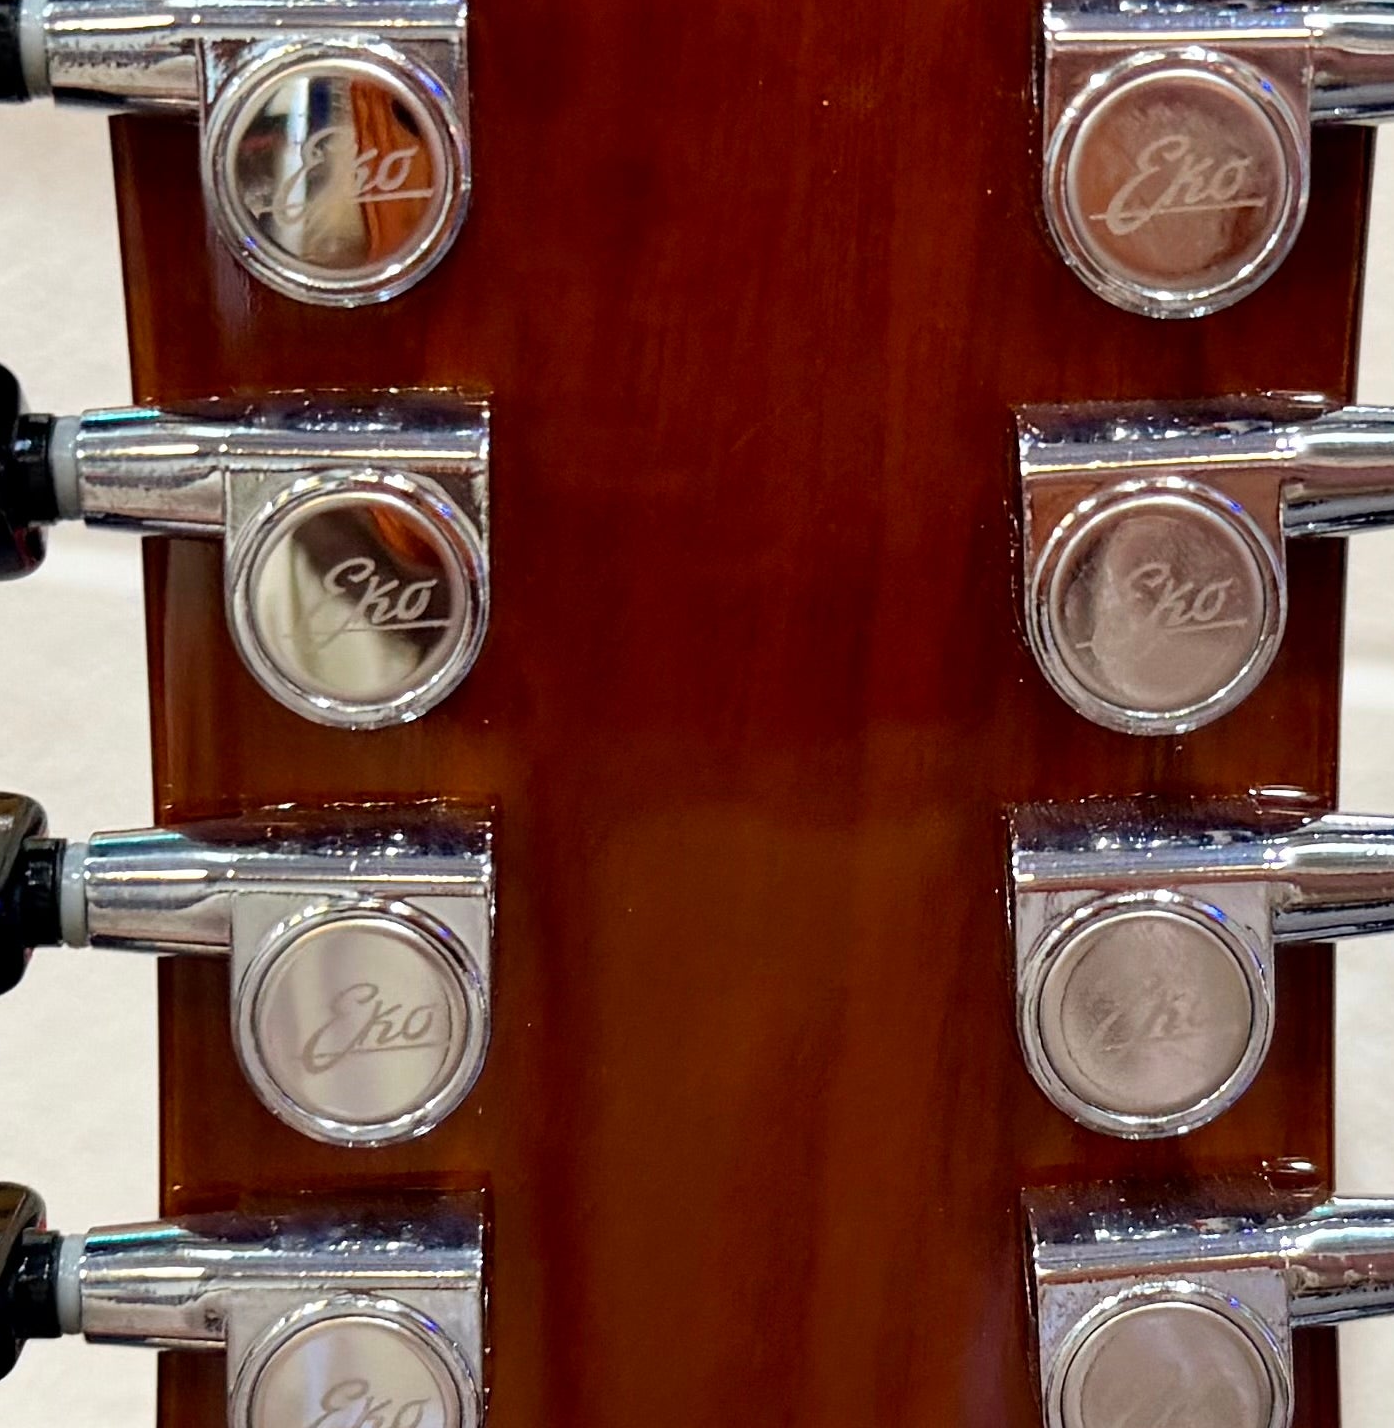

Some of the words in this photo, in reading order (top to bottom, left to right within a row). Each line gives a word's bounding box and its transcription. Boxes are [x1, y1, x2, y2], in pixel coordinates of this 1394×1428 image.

[258, 125, 434, 227] Eko
[1089, 134, 1268, 237] Eko
[296, 981, 450, 1075] Eko
